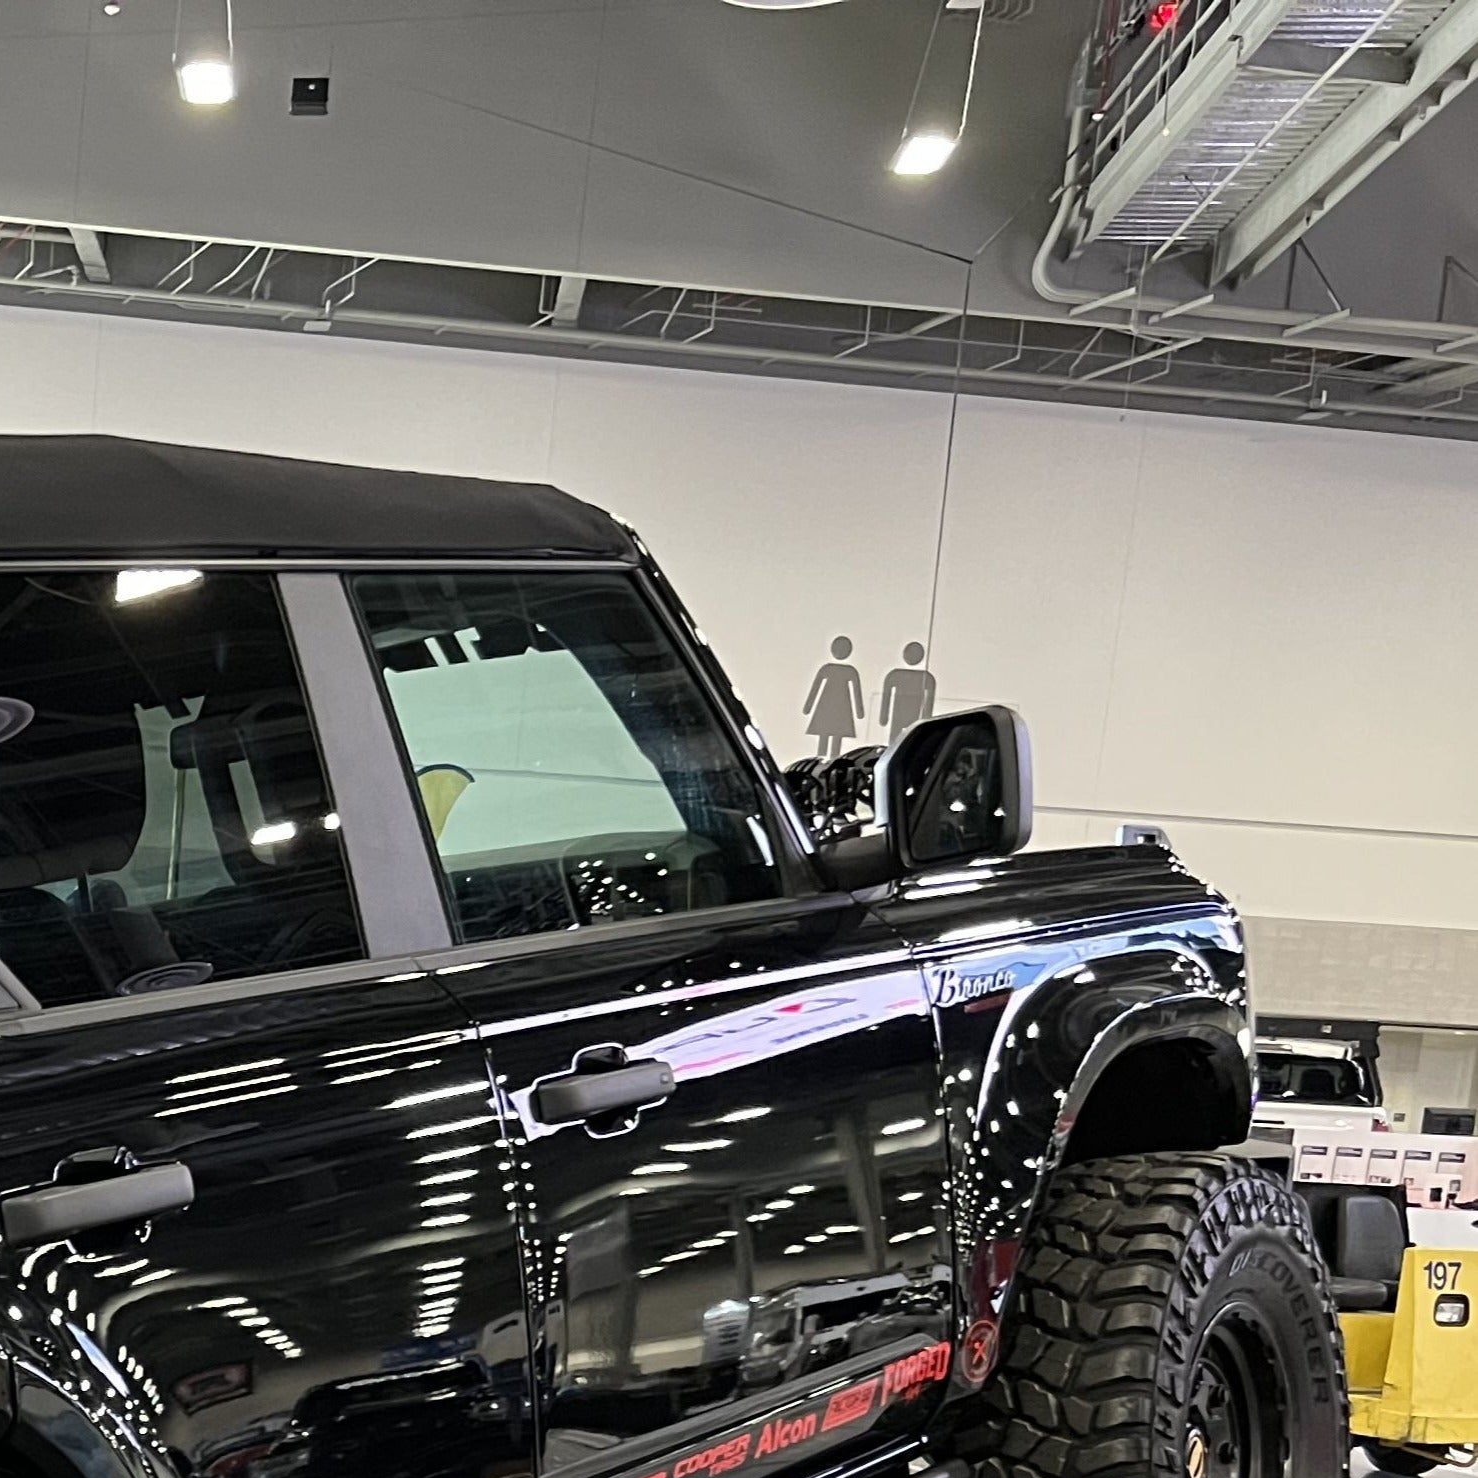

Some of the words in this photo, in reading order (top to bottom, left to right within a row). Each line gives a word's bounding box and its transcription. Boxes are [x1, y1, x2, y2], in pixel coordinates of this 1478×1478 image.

[932, 968, 1016, 1008] Bronco
[1423, 1260, 1462, 1291] 197
[880, 1341, 952, 1407] FORGED
[753, 1412, 816, 1459] Alcon
